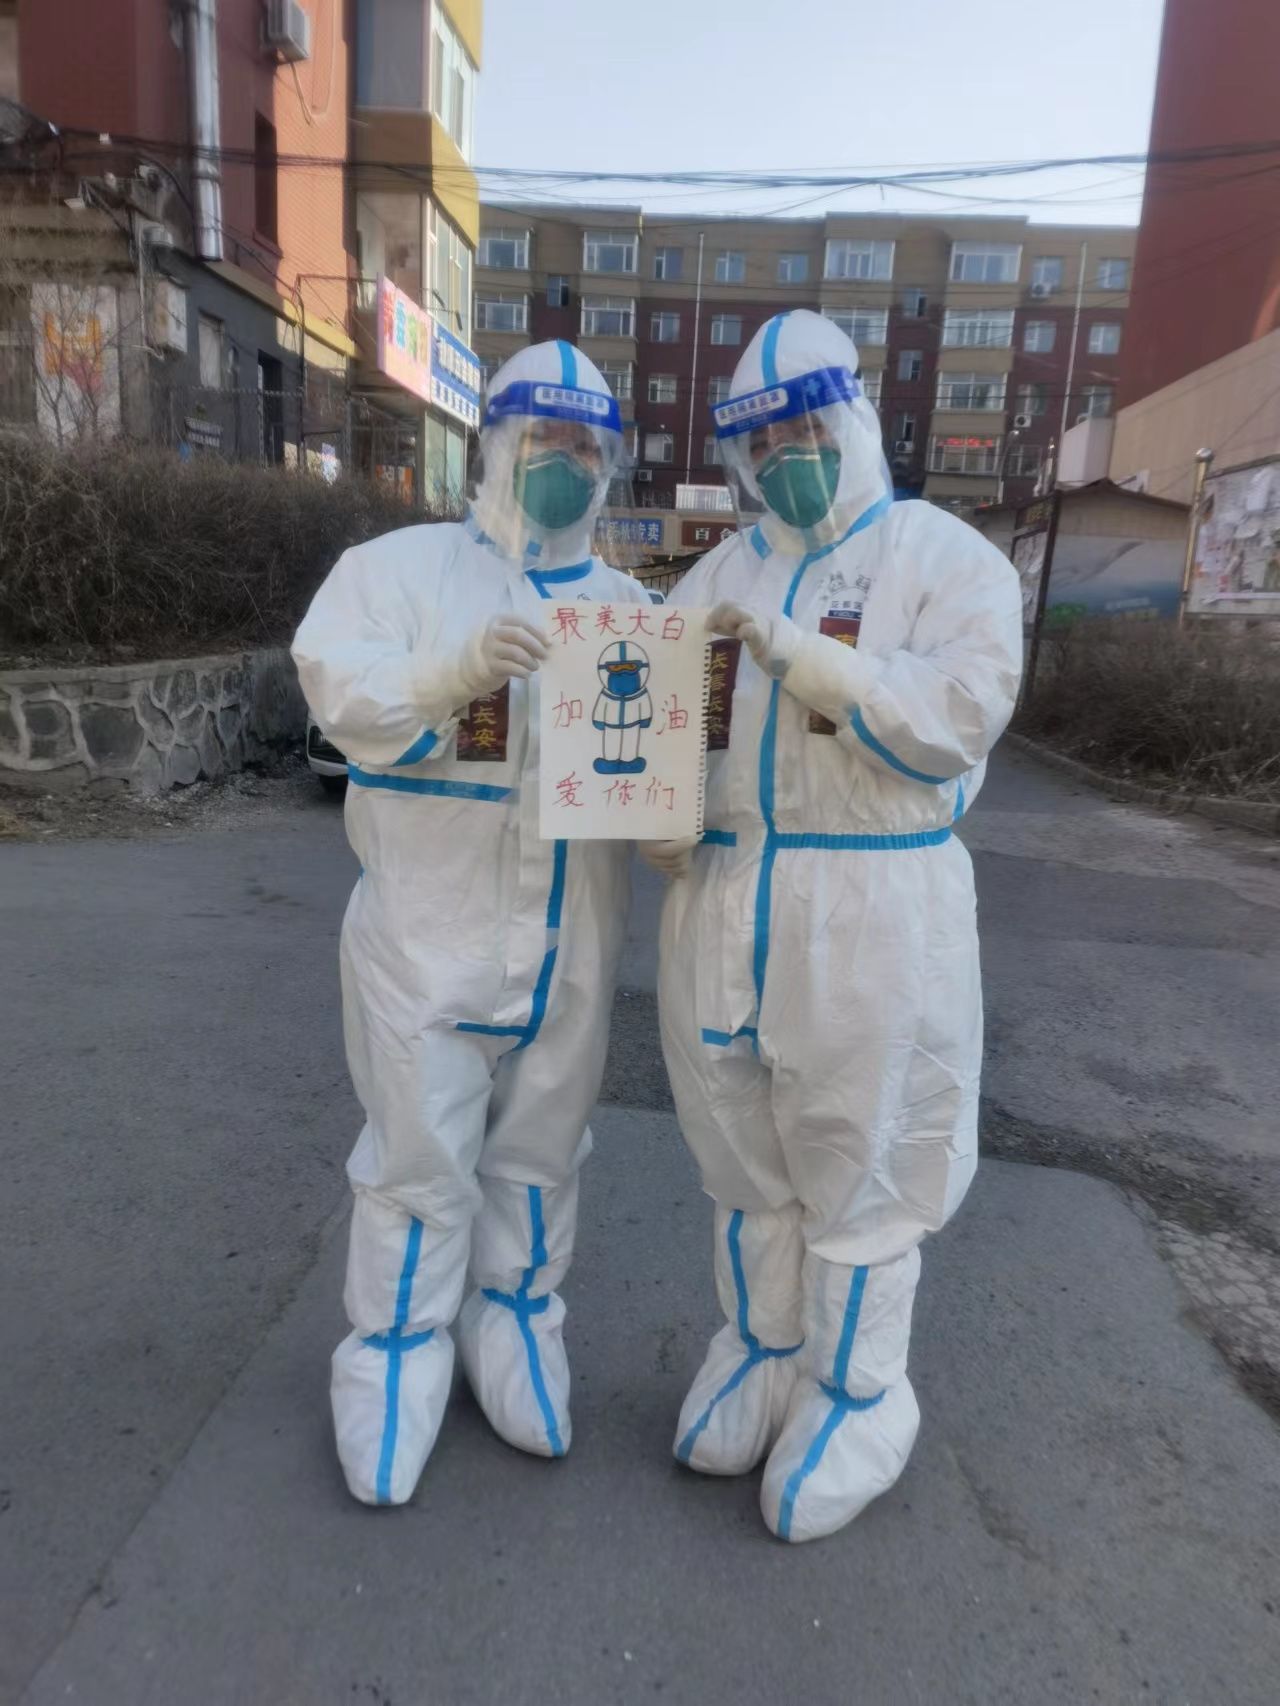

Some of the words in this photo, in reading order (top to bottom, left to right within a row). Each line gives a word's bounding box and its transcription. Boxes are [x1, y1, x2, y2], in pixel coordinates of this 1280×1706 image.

[551, 604, 685, 644] 最美大白
[551, 691, 583, 728] 加
[656, 693, 688, 735] 油
[552, 770, 675, 810] 爱你们
